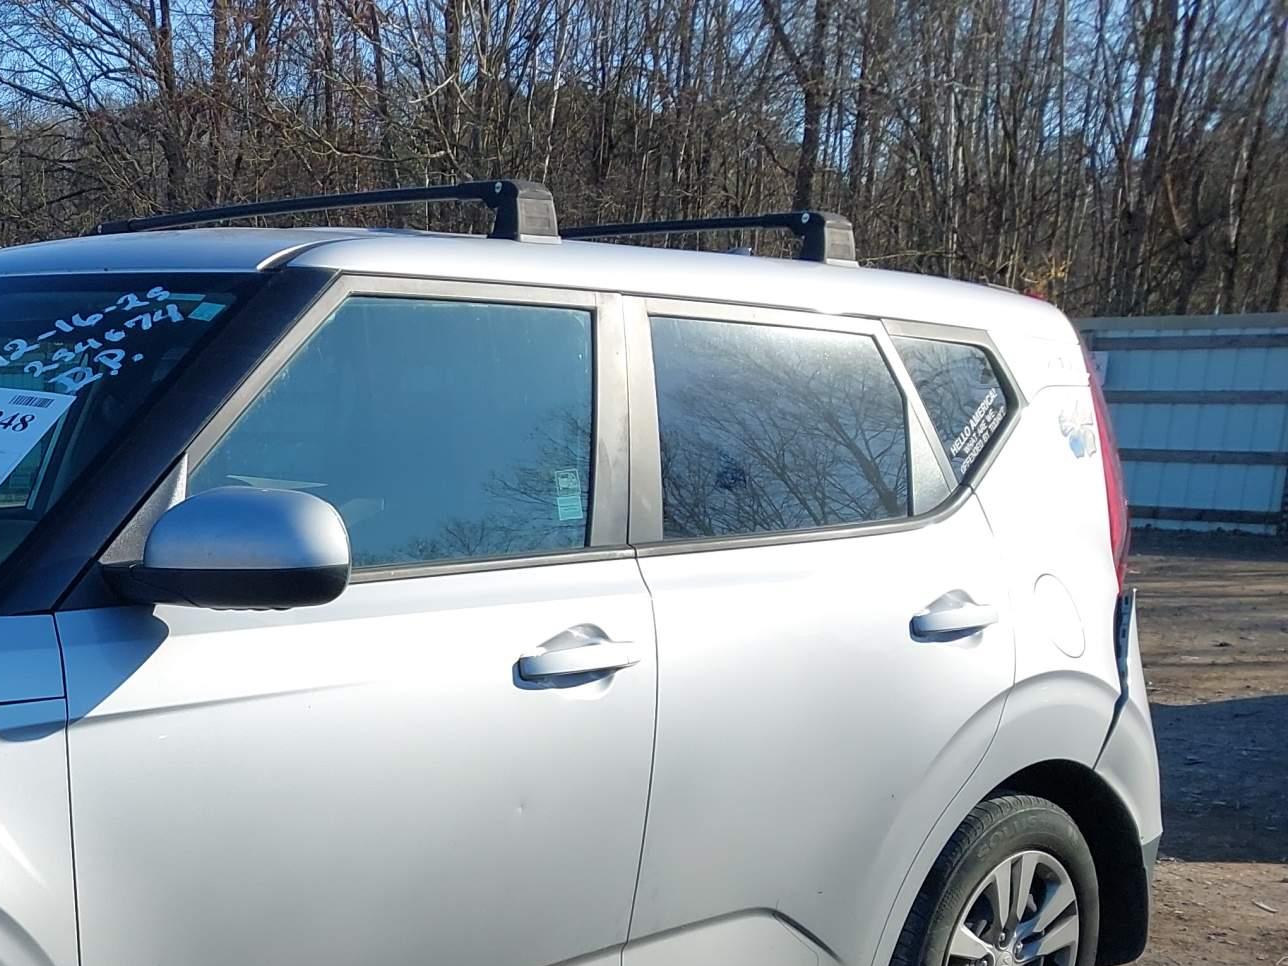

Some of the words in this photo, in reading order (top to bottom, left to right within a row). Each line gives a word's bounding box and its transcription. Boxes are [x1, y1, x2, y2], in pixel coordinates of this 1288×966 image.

[950, 426, 971, 457] HELLO
[969, 387, 998, 431] AMERICA!
[963, 432, 978, 454] WHAT
[977, 419, 988, 436] ARE
[960, 439, 985, 474] OFFENDED
[982, 430, 990, 443] BY
